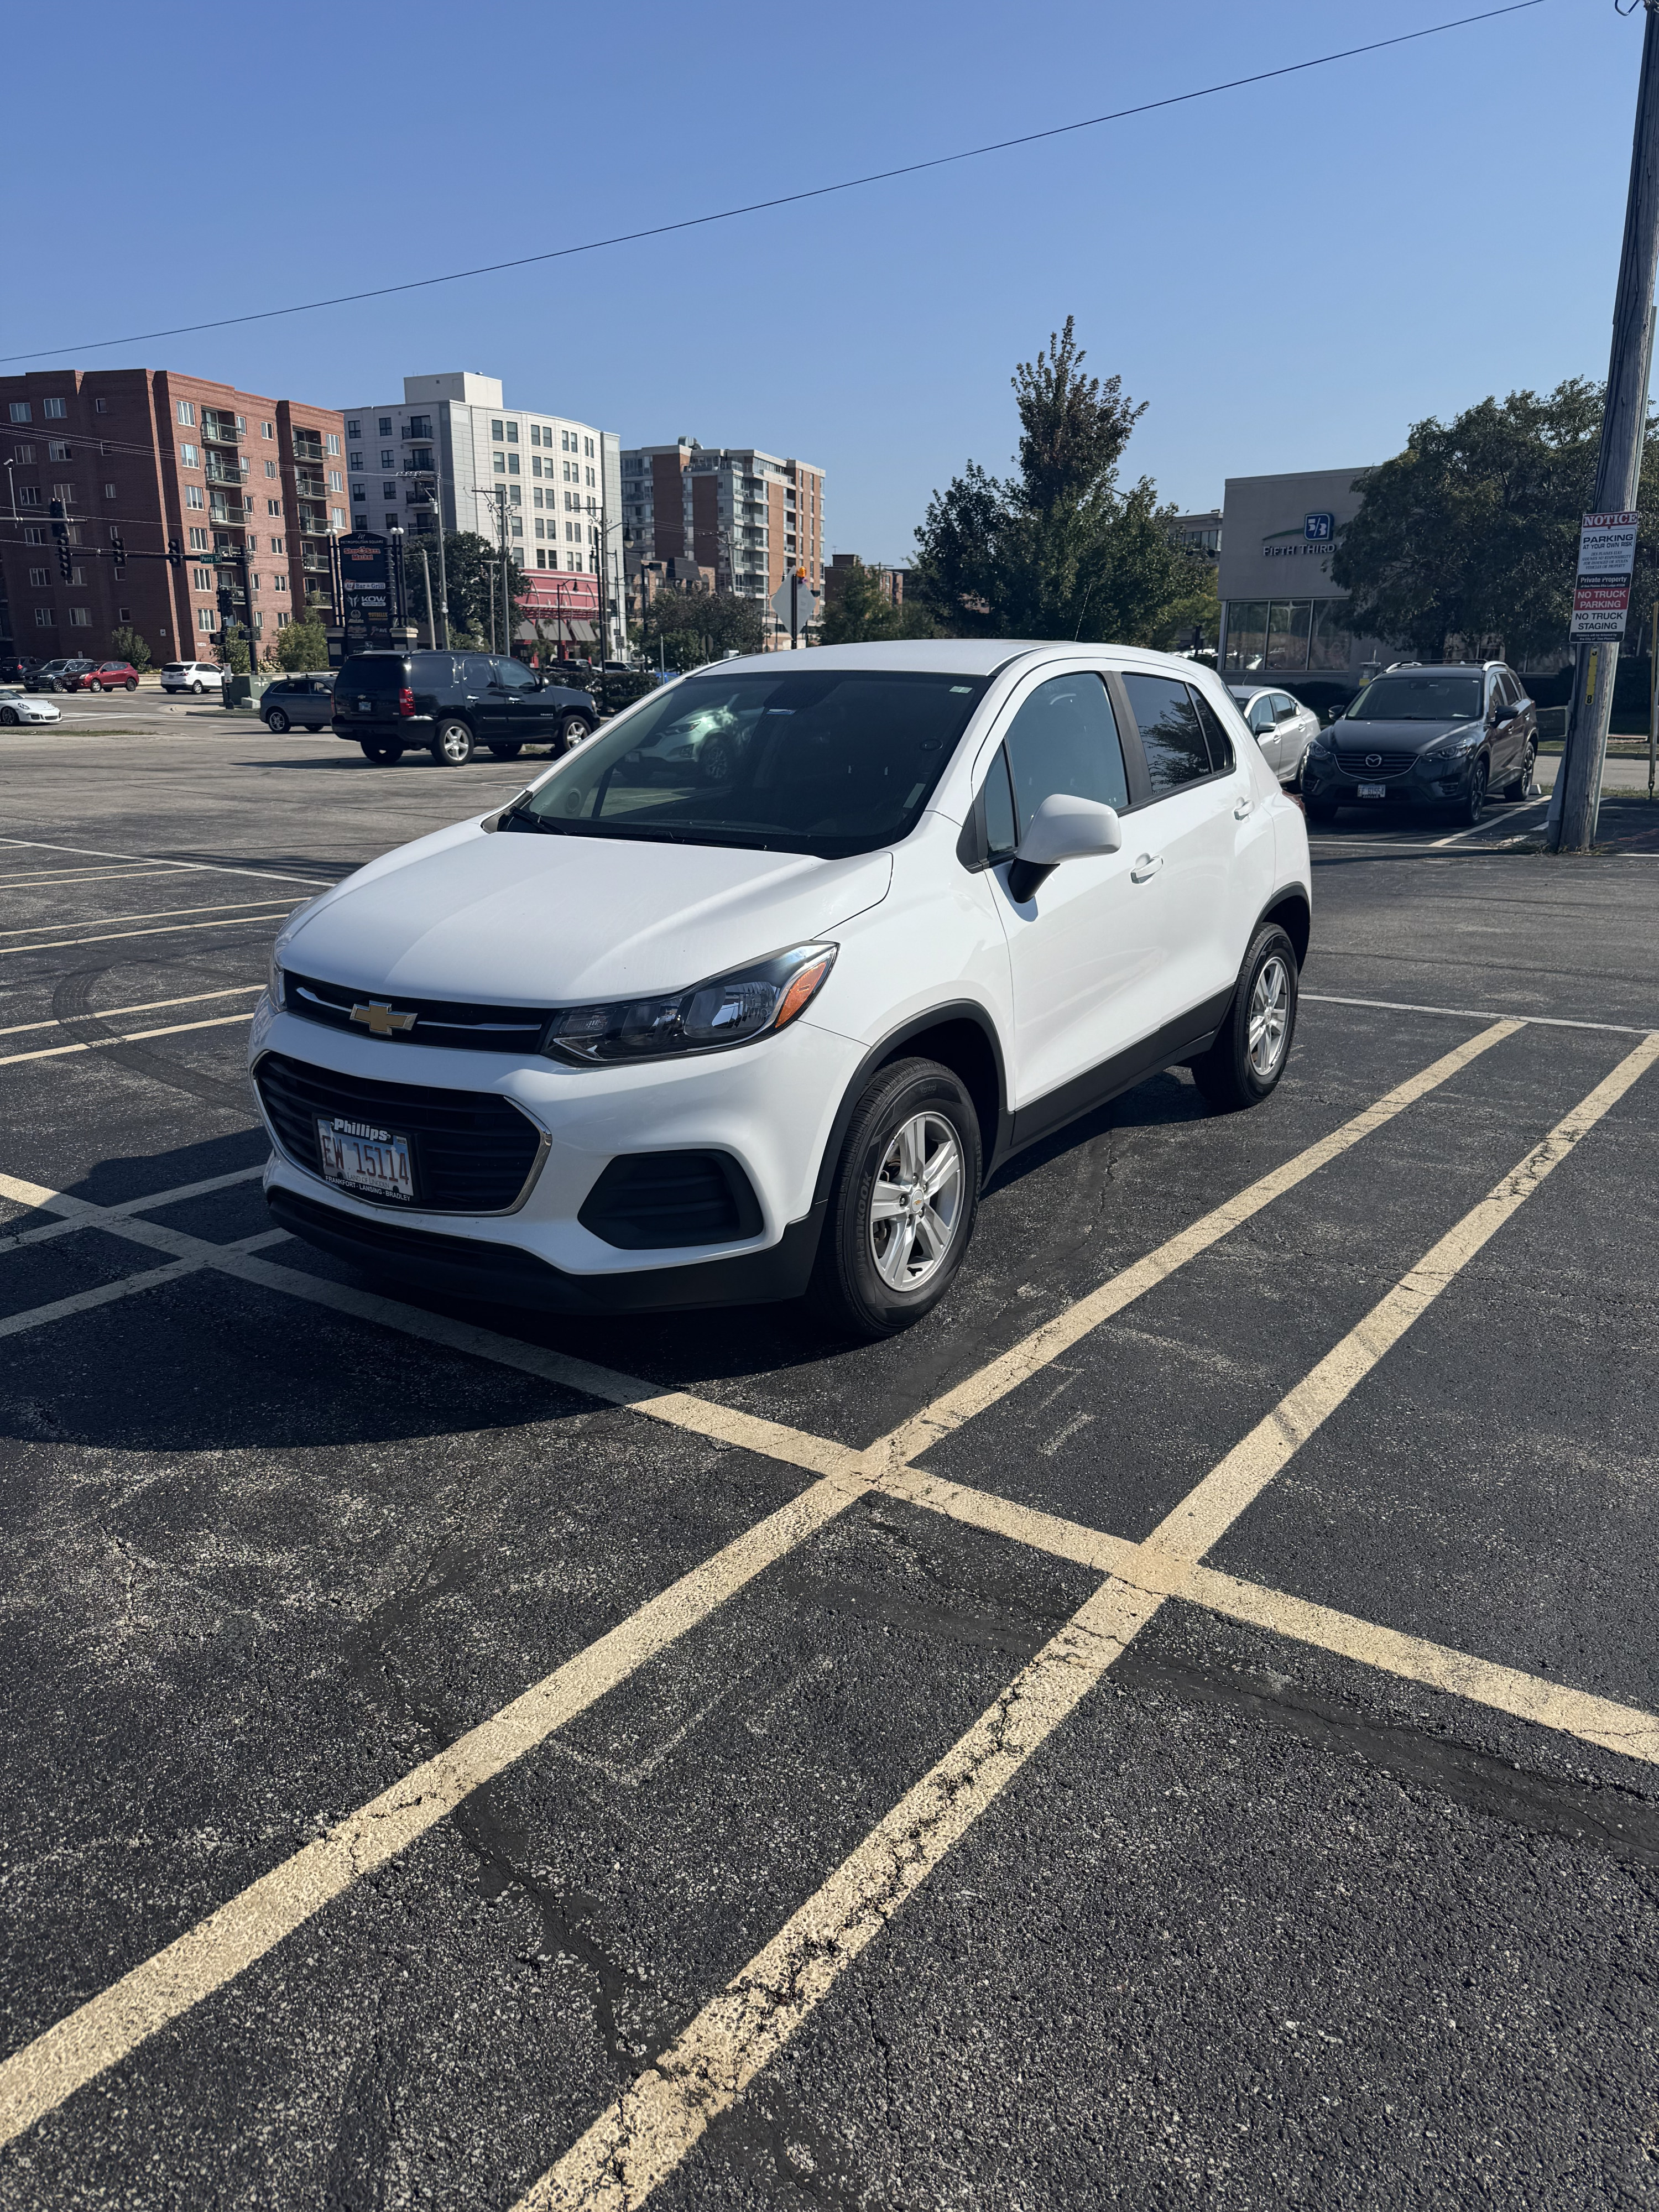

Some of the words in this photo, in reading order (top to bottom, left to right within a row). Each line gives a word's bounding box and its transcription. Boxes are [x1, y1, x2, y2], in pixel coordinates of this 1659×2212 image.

[1583, 513, 1637, 526] NOTICE
[1583, 534, 1634, 544] PARKING
[1263, 546, 1295, 556] FIFTH
[1299, 544, 1335, 554] THIRD
[1587, 695, 1593, 704] 8
[334, 1118, 388, 1141] Phillips
[322, 1135, 345, 1170] EW
[353, 1142, 409, 1185] 15114
[347, 1172, 361, 1182] LAND
[369, 1177, 389, 1188] LINCOLN
[325, 1175, 356, 1188] FRANKFORT
[359, 1183, 382, 1194] LANSING
[385, 1190, 410, 1202] BRADLEY
